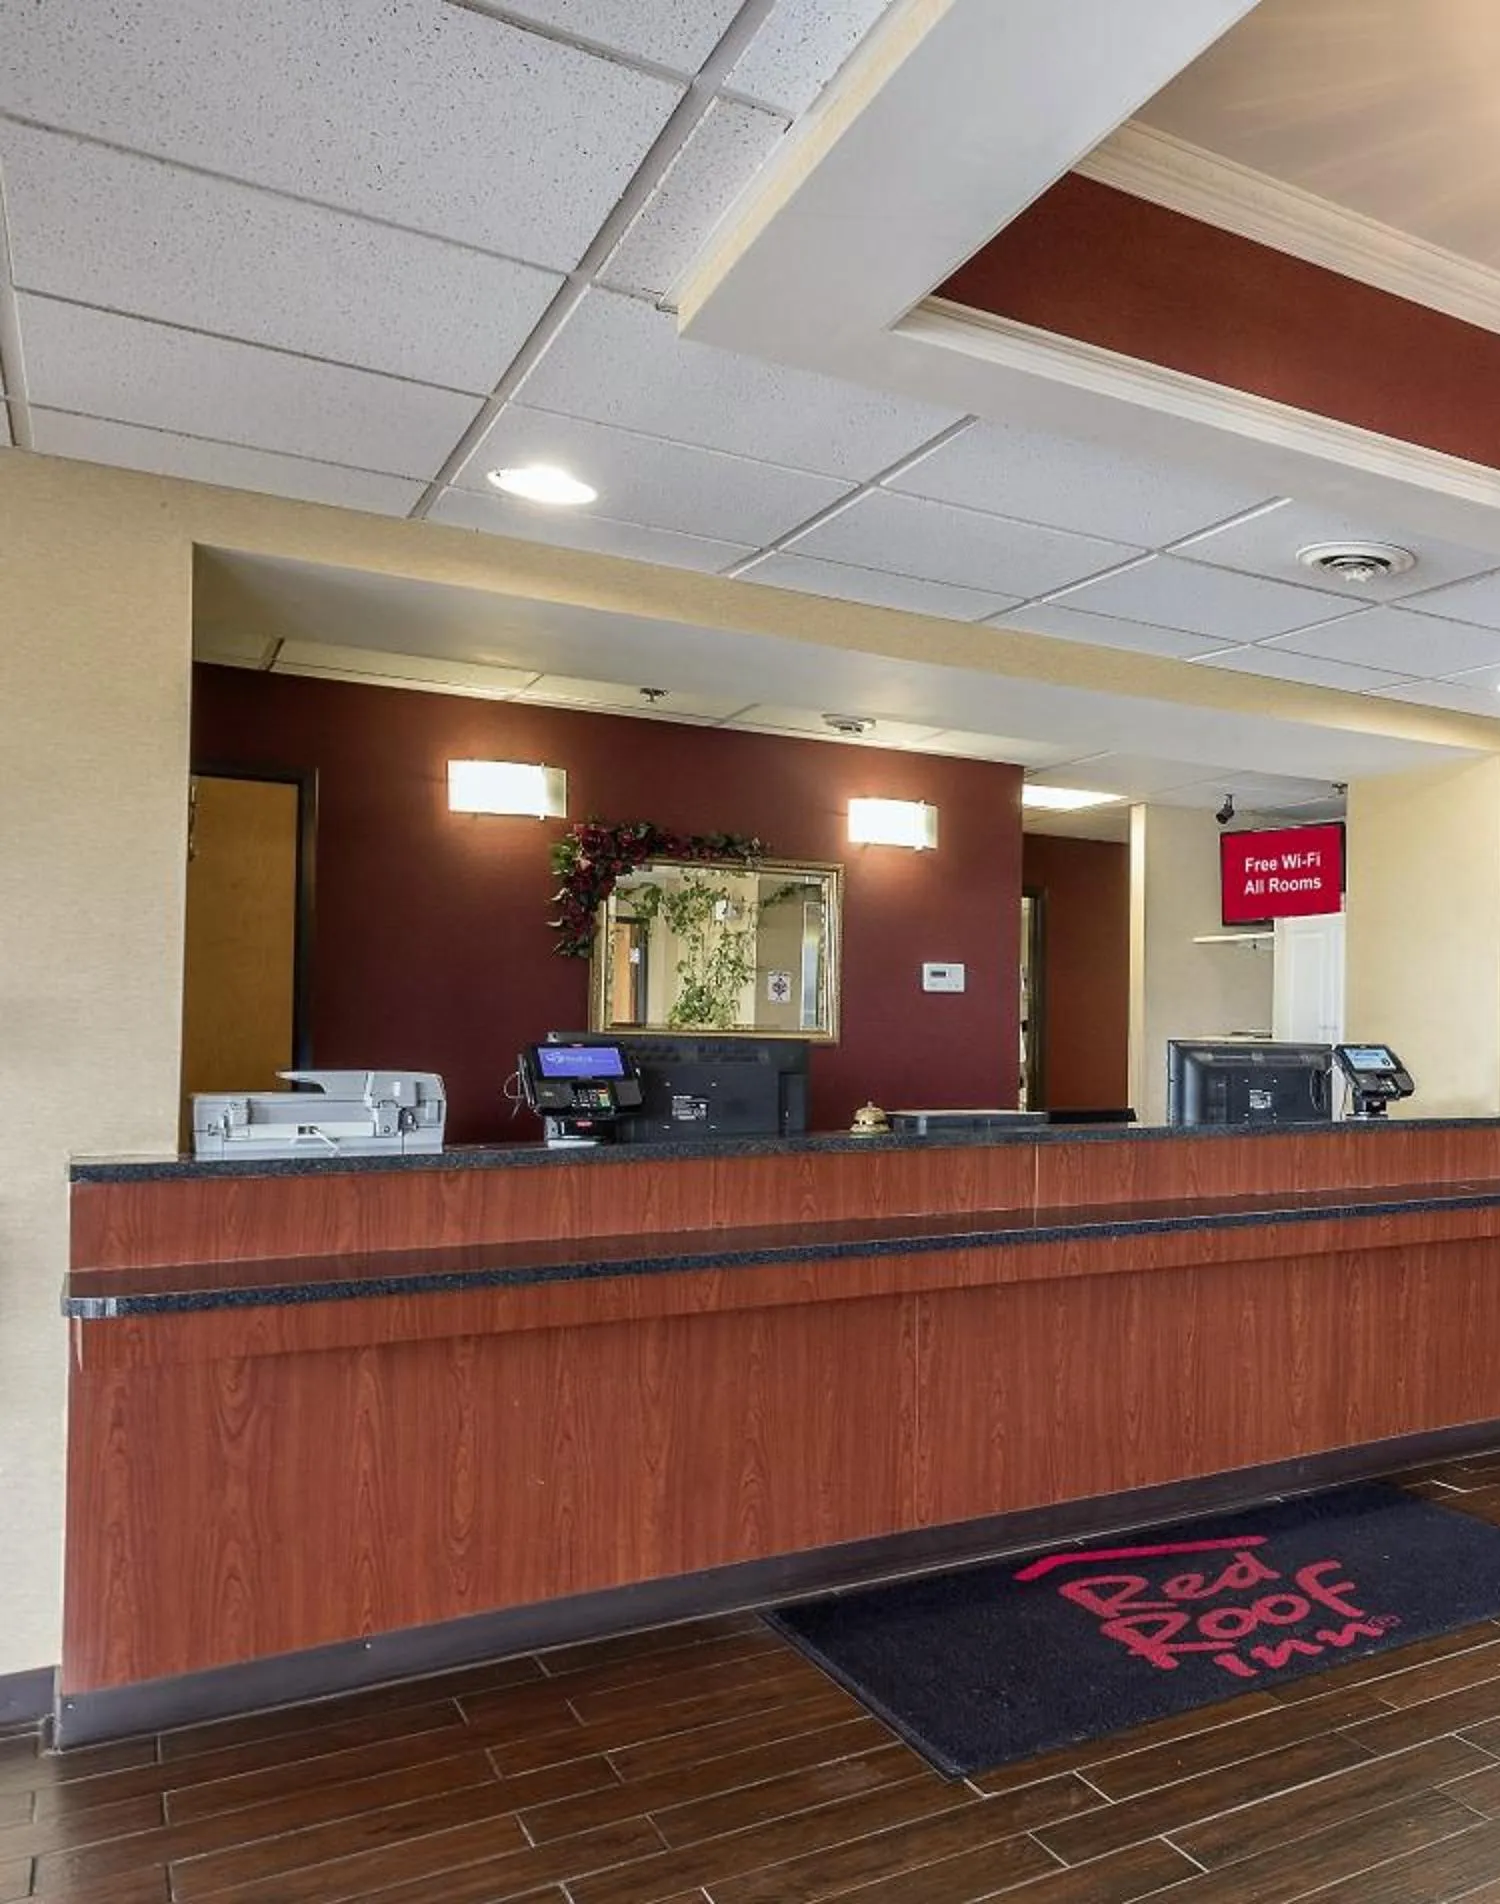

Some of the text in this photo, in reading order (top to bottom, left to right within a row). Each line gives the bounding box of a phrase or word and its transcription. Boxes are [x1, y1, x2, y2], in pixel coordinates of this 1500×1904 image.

[1245, 852, 1321, 873] Free Wi-Fi
[1244, 877, 1322, 895] All Rooms
[1058, 1551, 1281, 1618] Red
